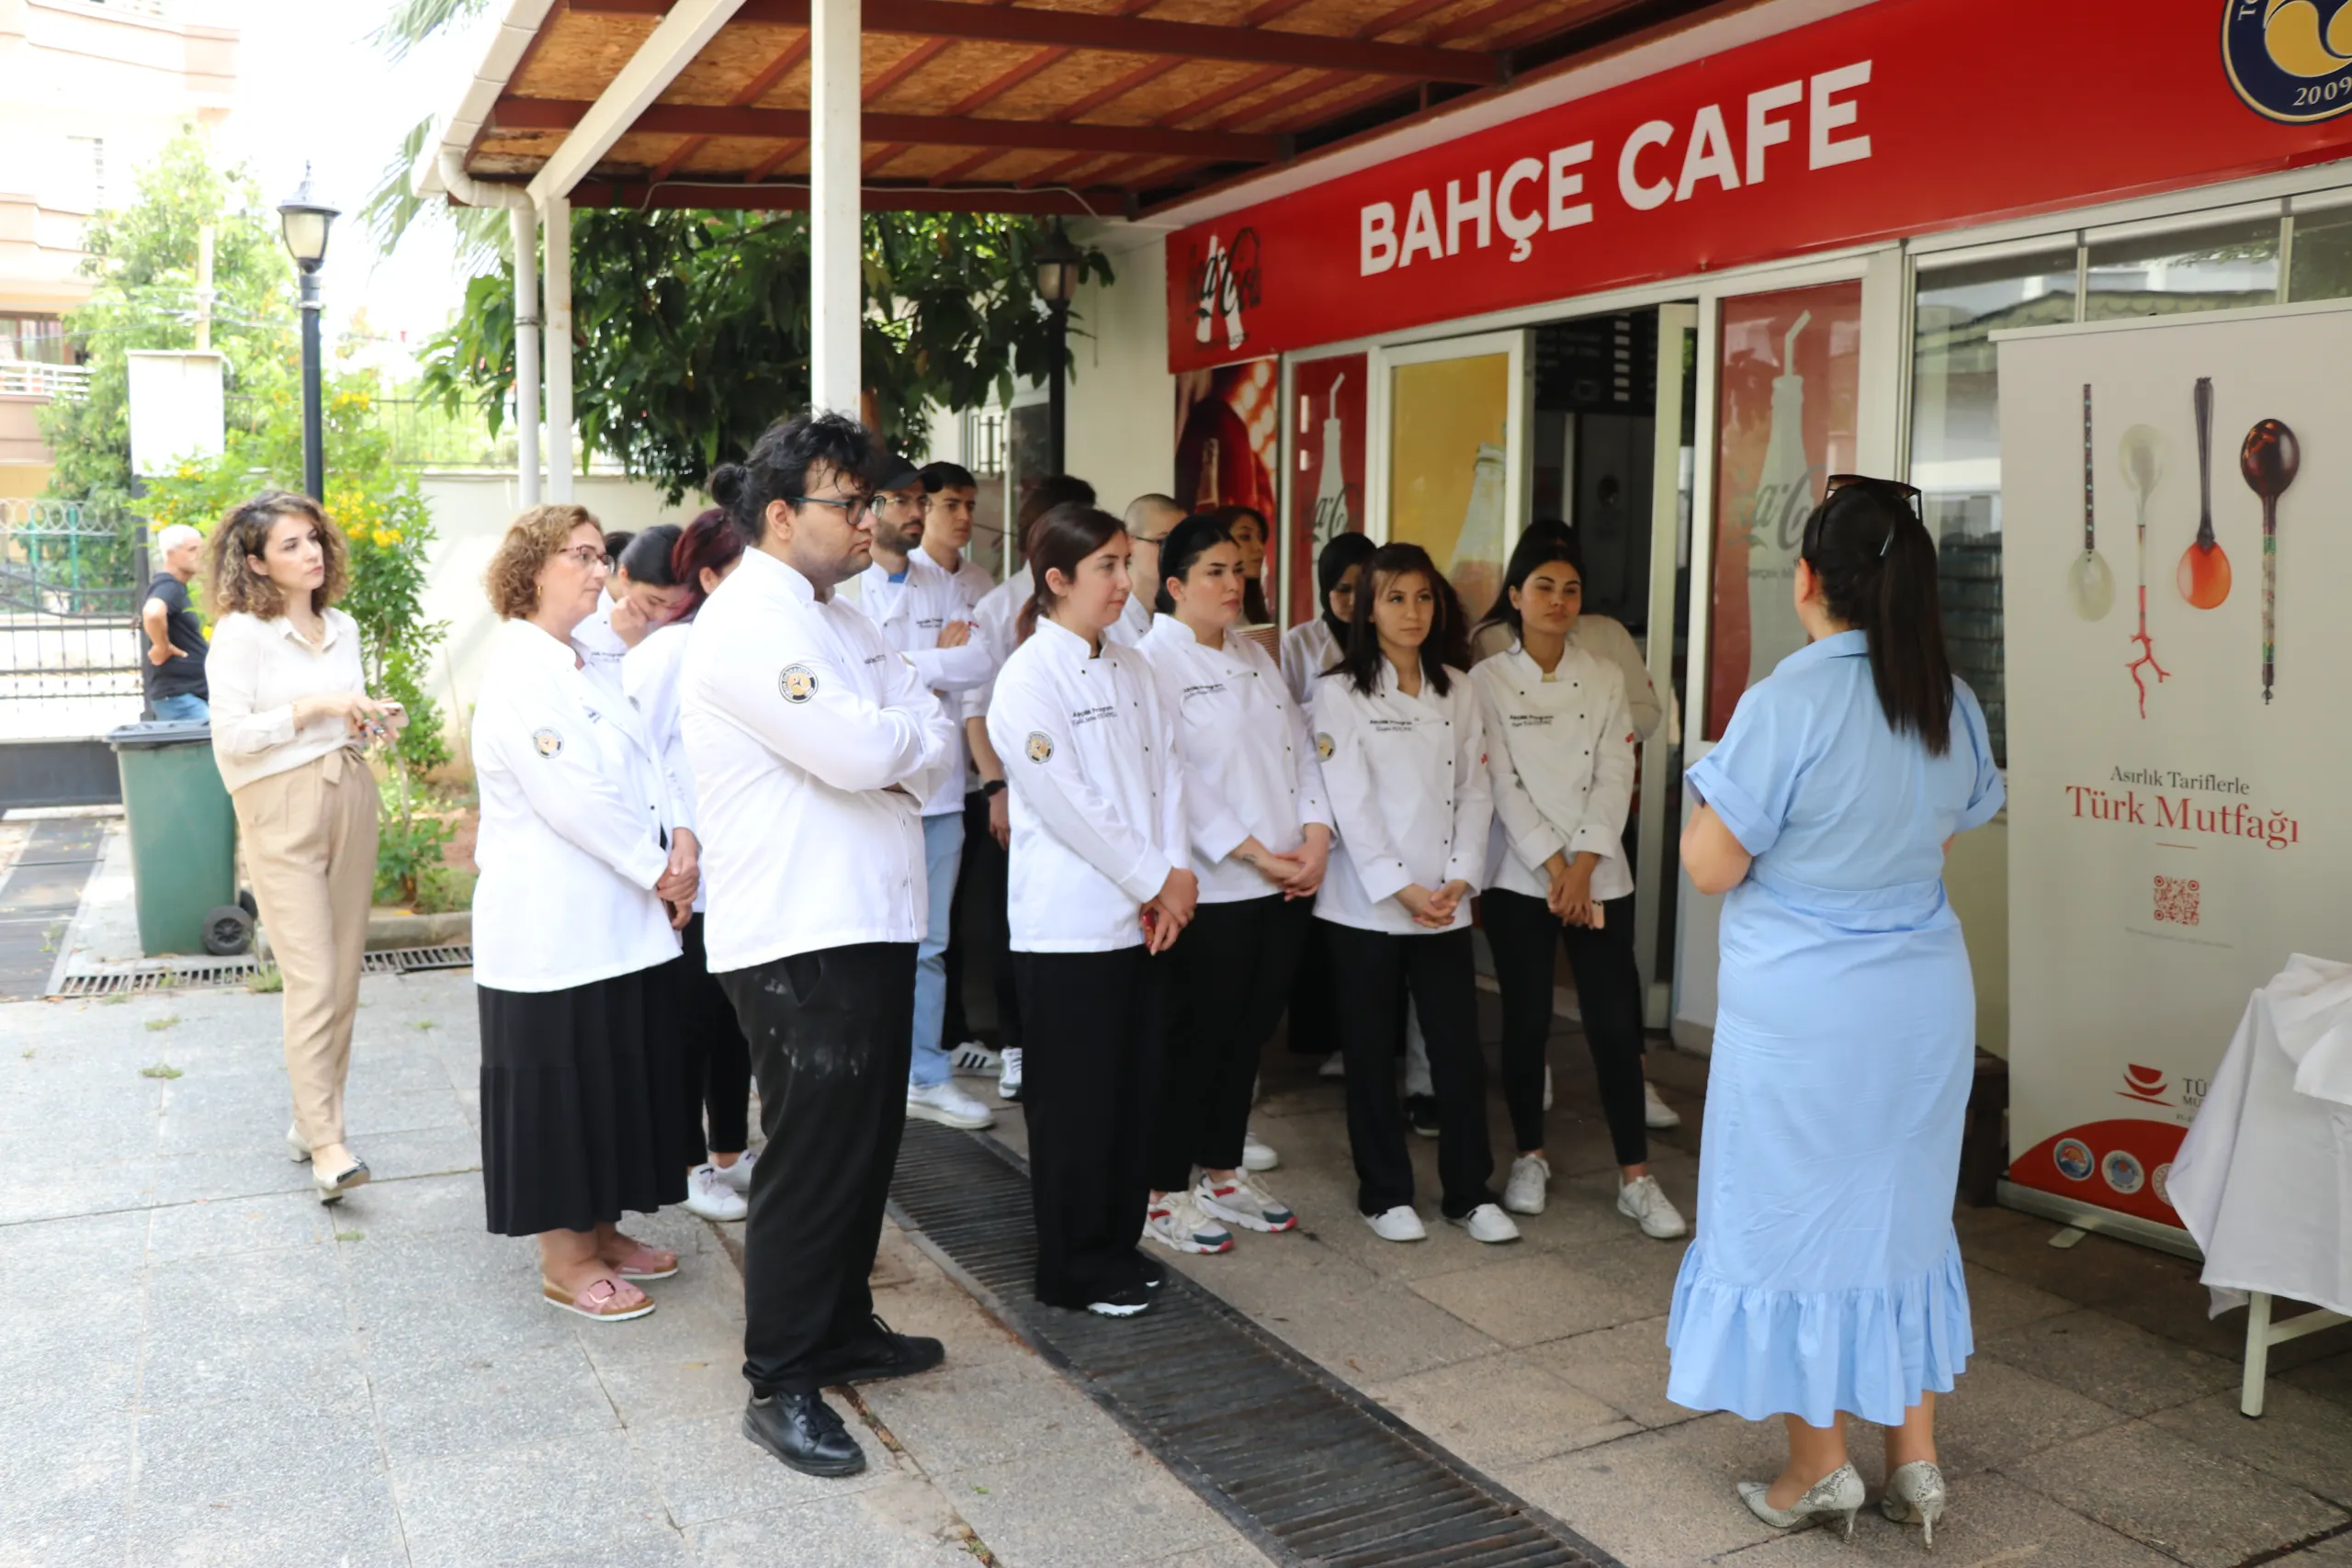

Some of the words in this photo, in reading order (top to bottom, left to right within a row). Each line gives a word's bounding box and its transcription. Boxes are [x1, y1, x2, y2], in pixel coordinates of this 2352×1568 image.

[2292, 76, 2352, 107] 2009
[1361, 140, 1594, 276] BAHÇE
[1617, 59, 1872, 211] CAFE
[2109, 765, 2164, 787] Asırlık
[2166, 772, 2250, 795] Tariflerle
[2065, 785, 2146, 825] Türk
[2154, 795, 2300, 851] Mutfağı
[2182, 1077, 2211, 1097] TÜ
[2183, 1095, 2204, 1108] MU
